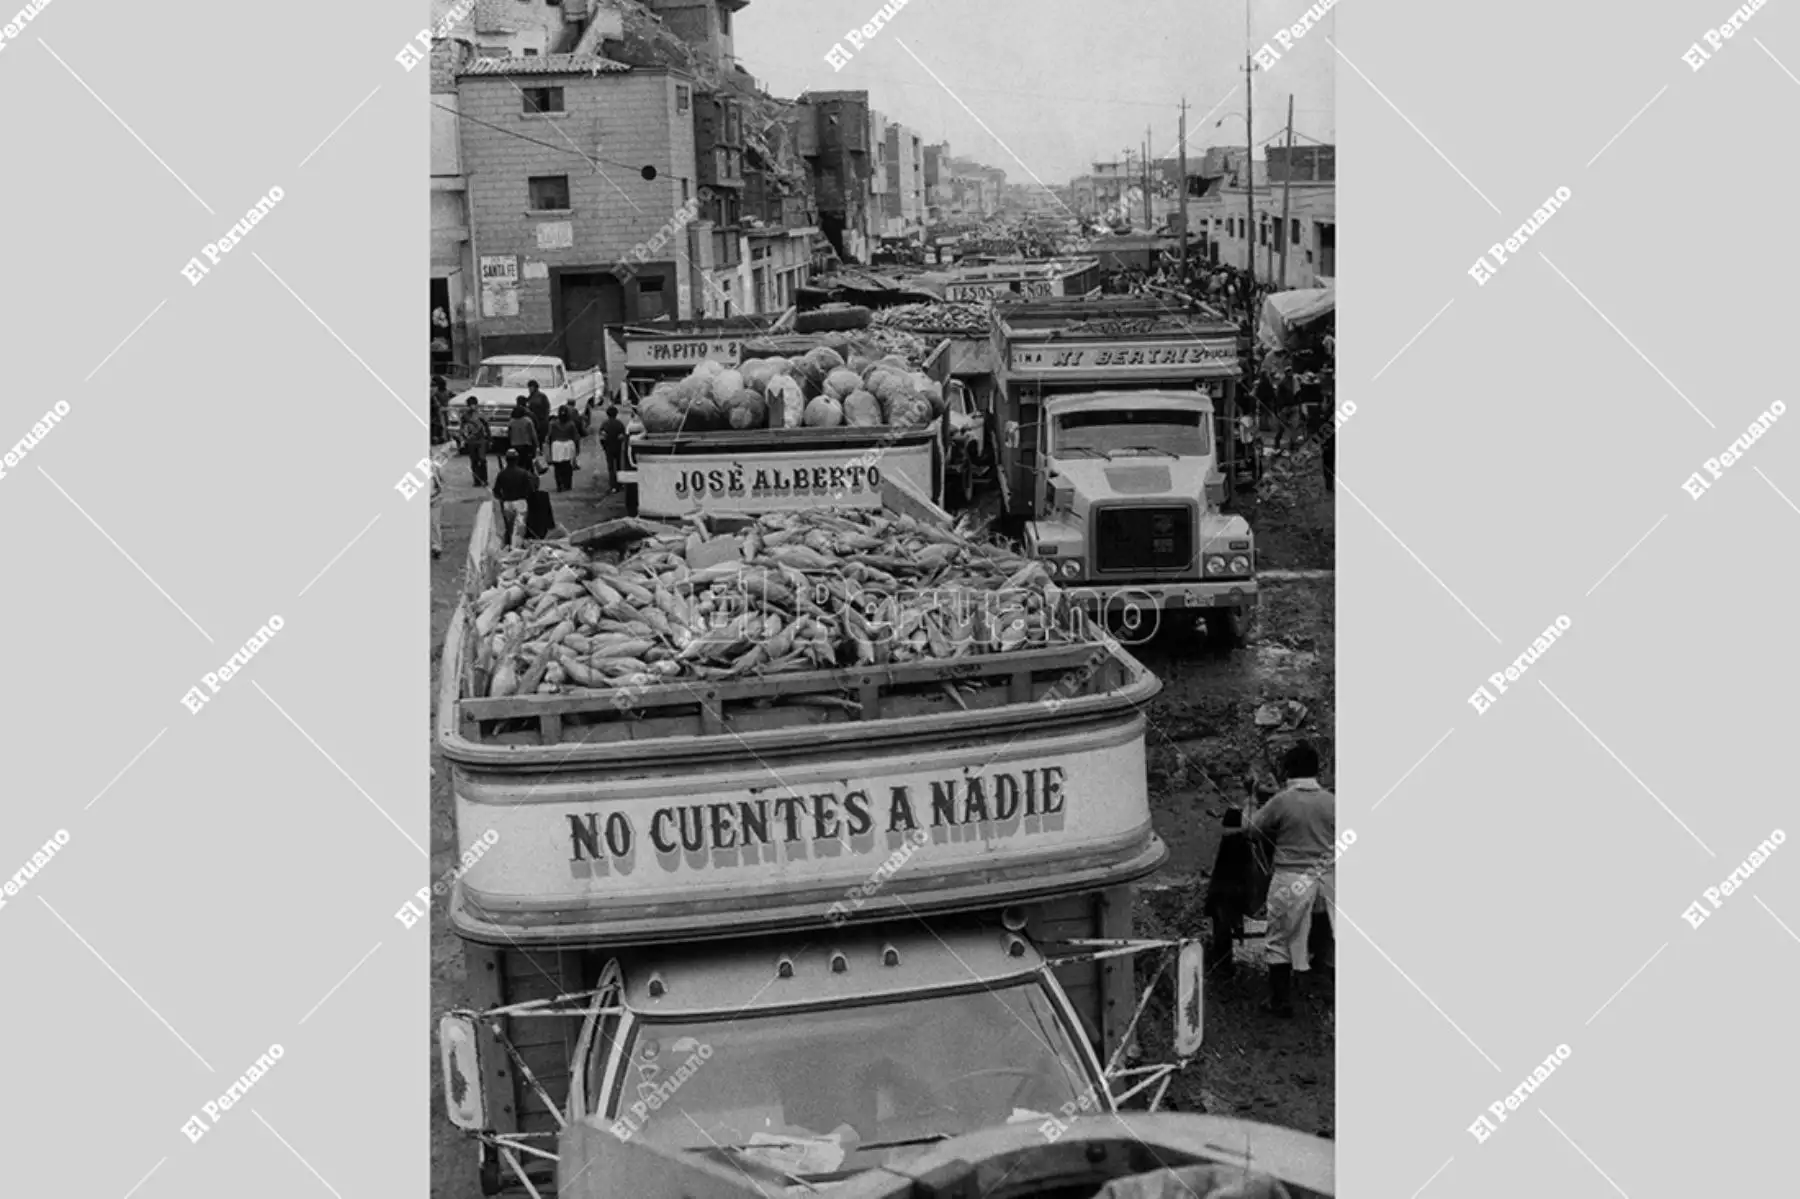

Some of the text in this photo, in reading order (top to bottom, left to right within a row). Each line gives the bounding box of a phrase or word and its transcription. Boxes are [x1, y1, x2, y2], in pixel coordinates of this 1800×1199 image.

[728, 341, 737, 357] 2
[752, 465, 880, 491] ALBERTO
[565, 765, 1066, 863] NO CUENTES A NADIE
